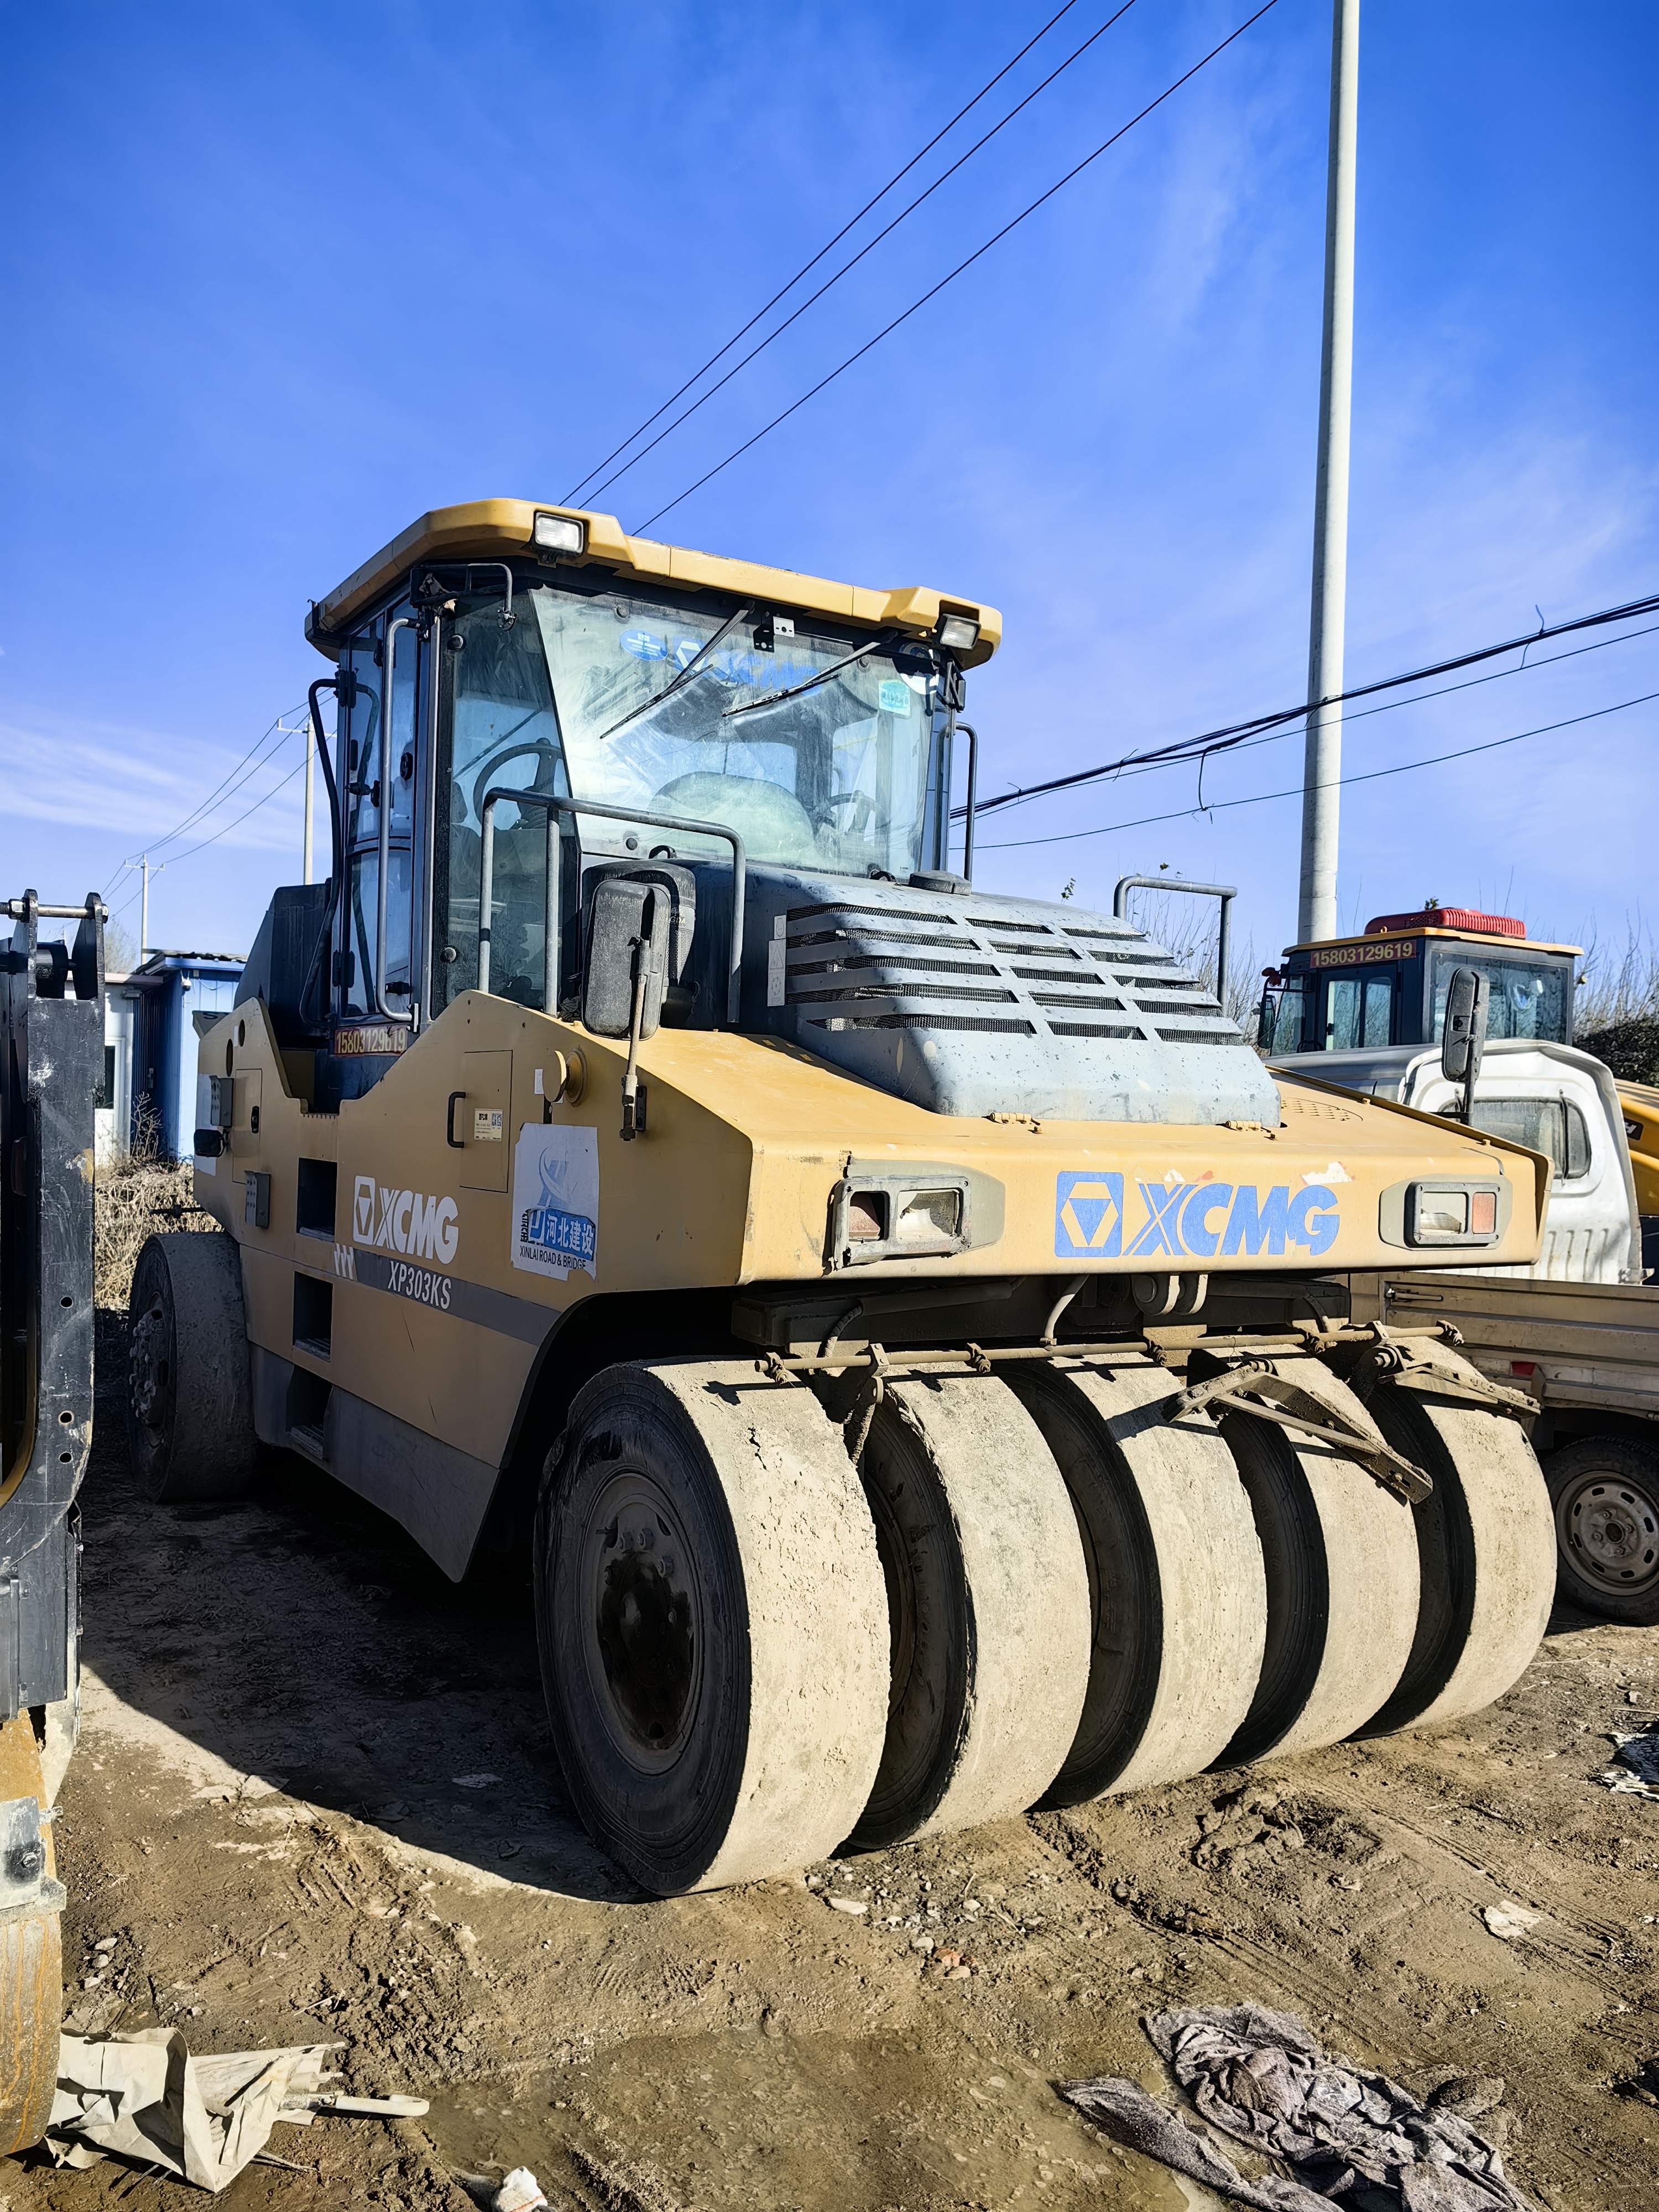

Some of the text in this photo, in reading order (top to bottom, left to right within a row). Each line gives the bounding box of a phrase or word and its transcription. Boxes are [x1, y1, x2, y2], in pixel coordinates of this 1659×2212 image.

[1313, 942, 1413, 967] 15803129619
[336, 1027, 406, 1054] 15803129619
[375, 1187, 459, 1264] XCMG
[546, 1214, 594, 1256] 河北建设
[1121, 1183, 1340, 1258] XCMG
[520, 1245, 539, 1261] XINLAI
[539, 1250, 556, 1265] ROAD
[557, 1254, 562, 1266] &
[388, 1261, 452, 1310] XP303KS
